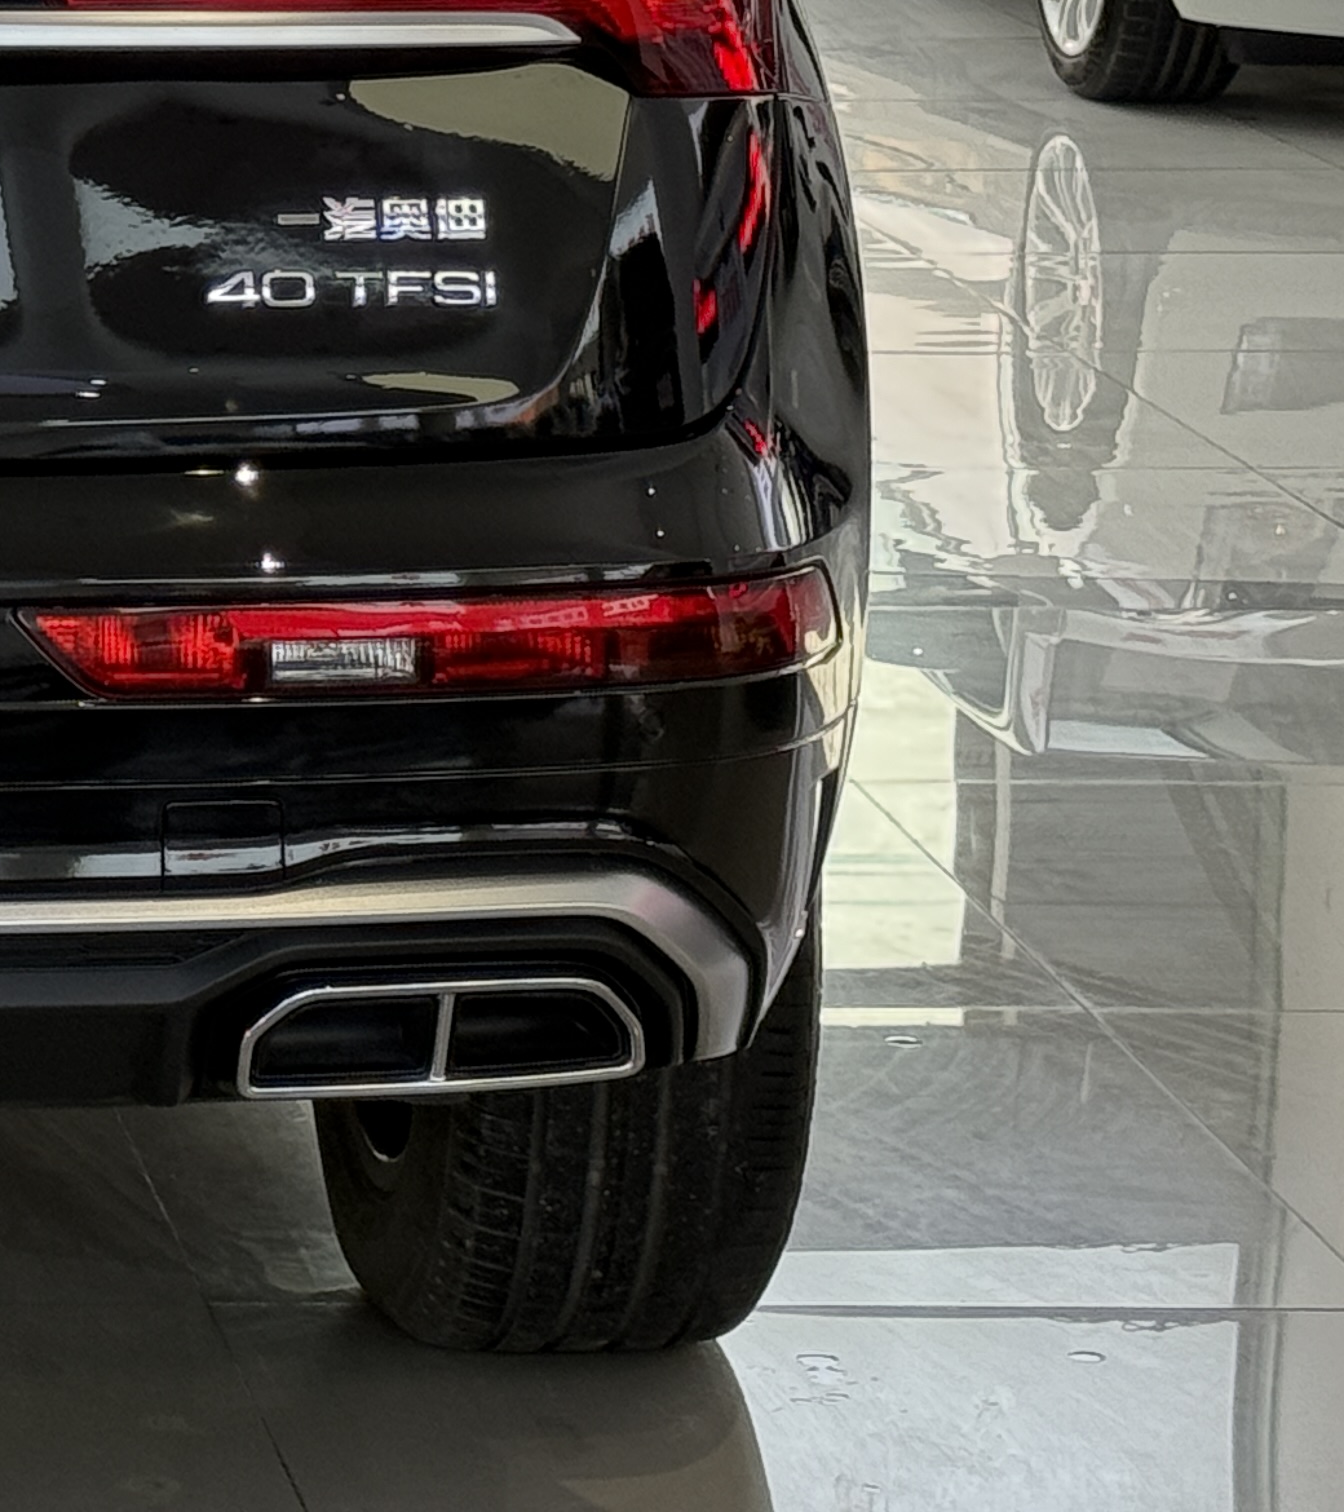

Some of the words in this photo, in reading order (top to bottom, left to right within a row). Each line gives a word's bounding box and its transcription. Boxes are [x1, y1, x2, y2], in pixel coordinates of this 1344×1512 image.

[276, 196, 487, 240] 一汽奥迪
[207, 269, 316, 308] 40
[334, 269, 496, 308] TFSI
